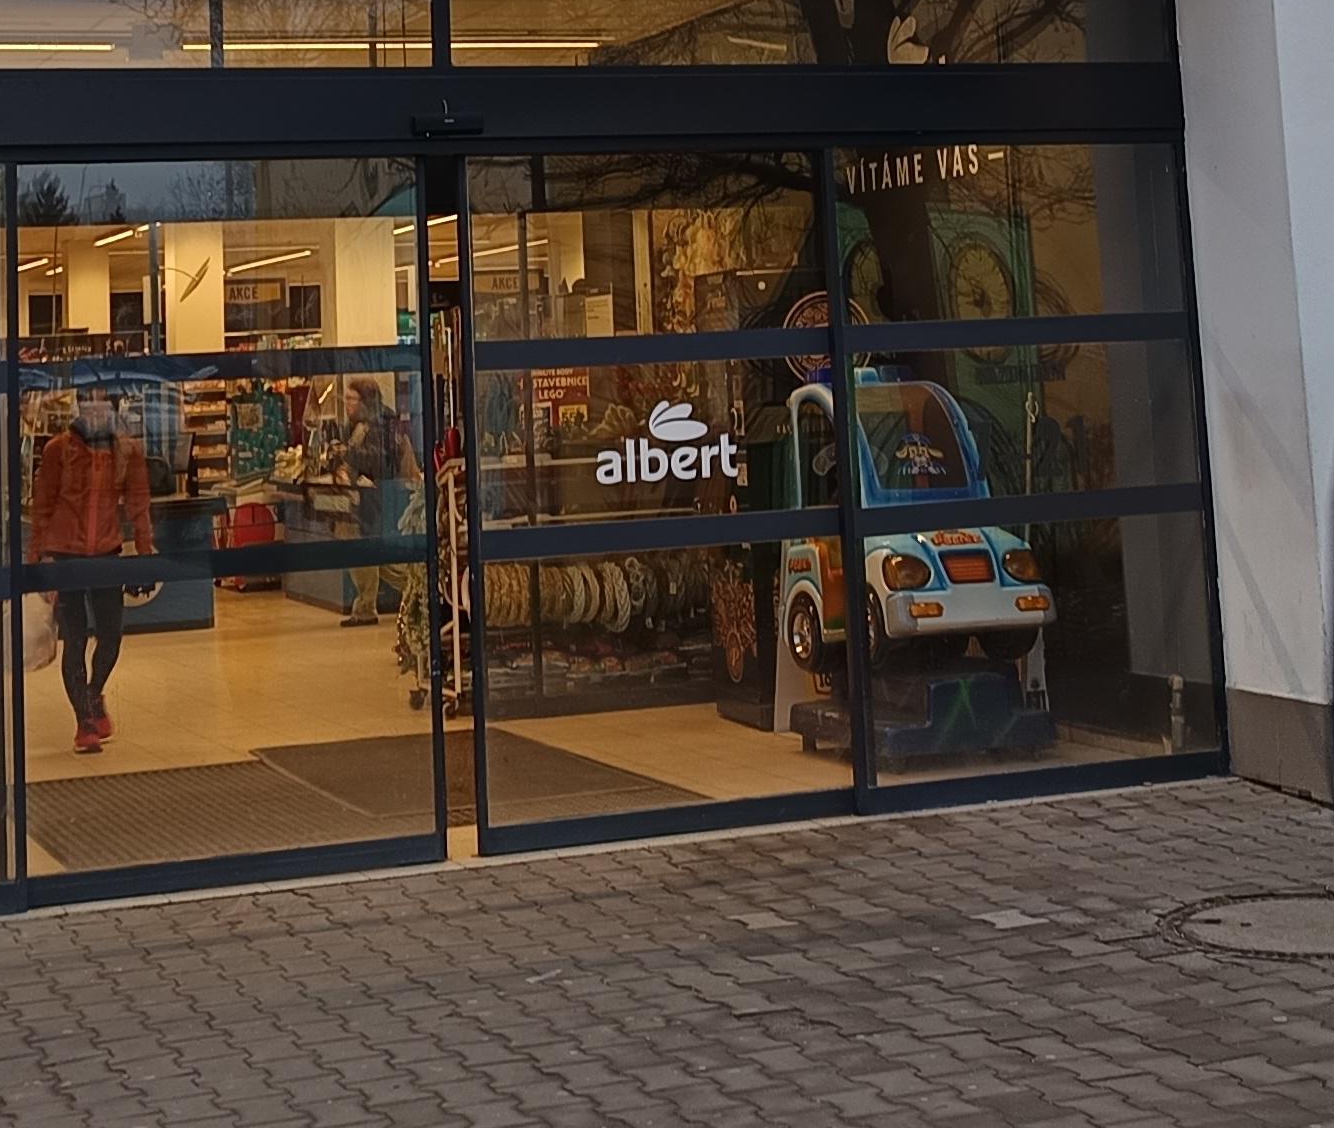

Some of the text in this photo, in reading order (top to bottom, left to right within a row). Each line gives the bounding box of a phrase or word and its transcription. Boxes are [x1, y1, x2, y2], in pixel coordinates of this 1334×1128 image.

[846, 152, 924, 194] VÍTÁME
[491, 276, 519, 291] AKCE
[229, 285, 259, 301] AKCE
[533, 376, 587, 388] STAVEBNICE
[595, 430, 740, 486] albert
